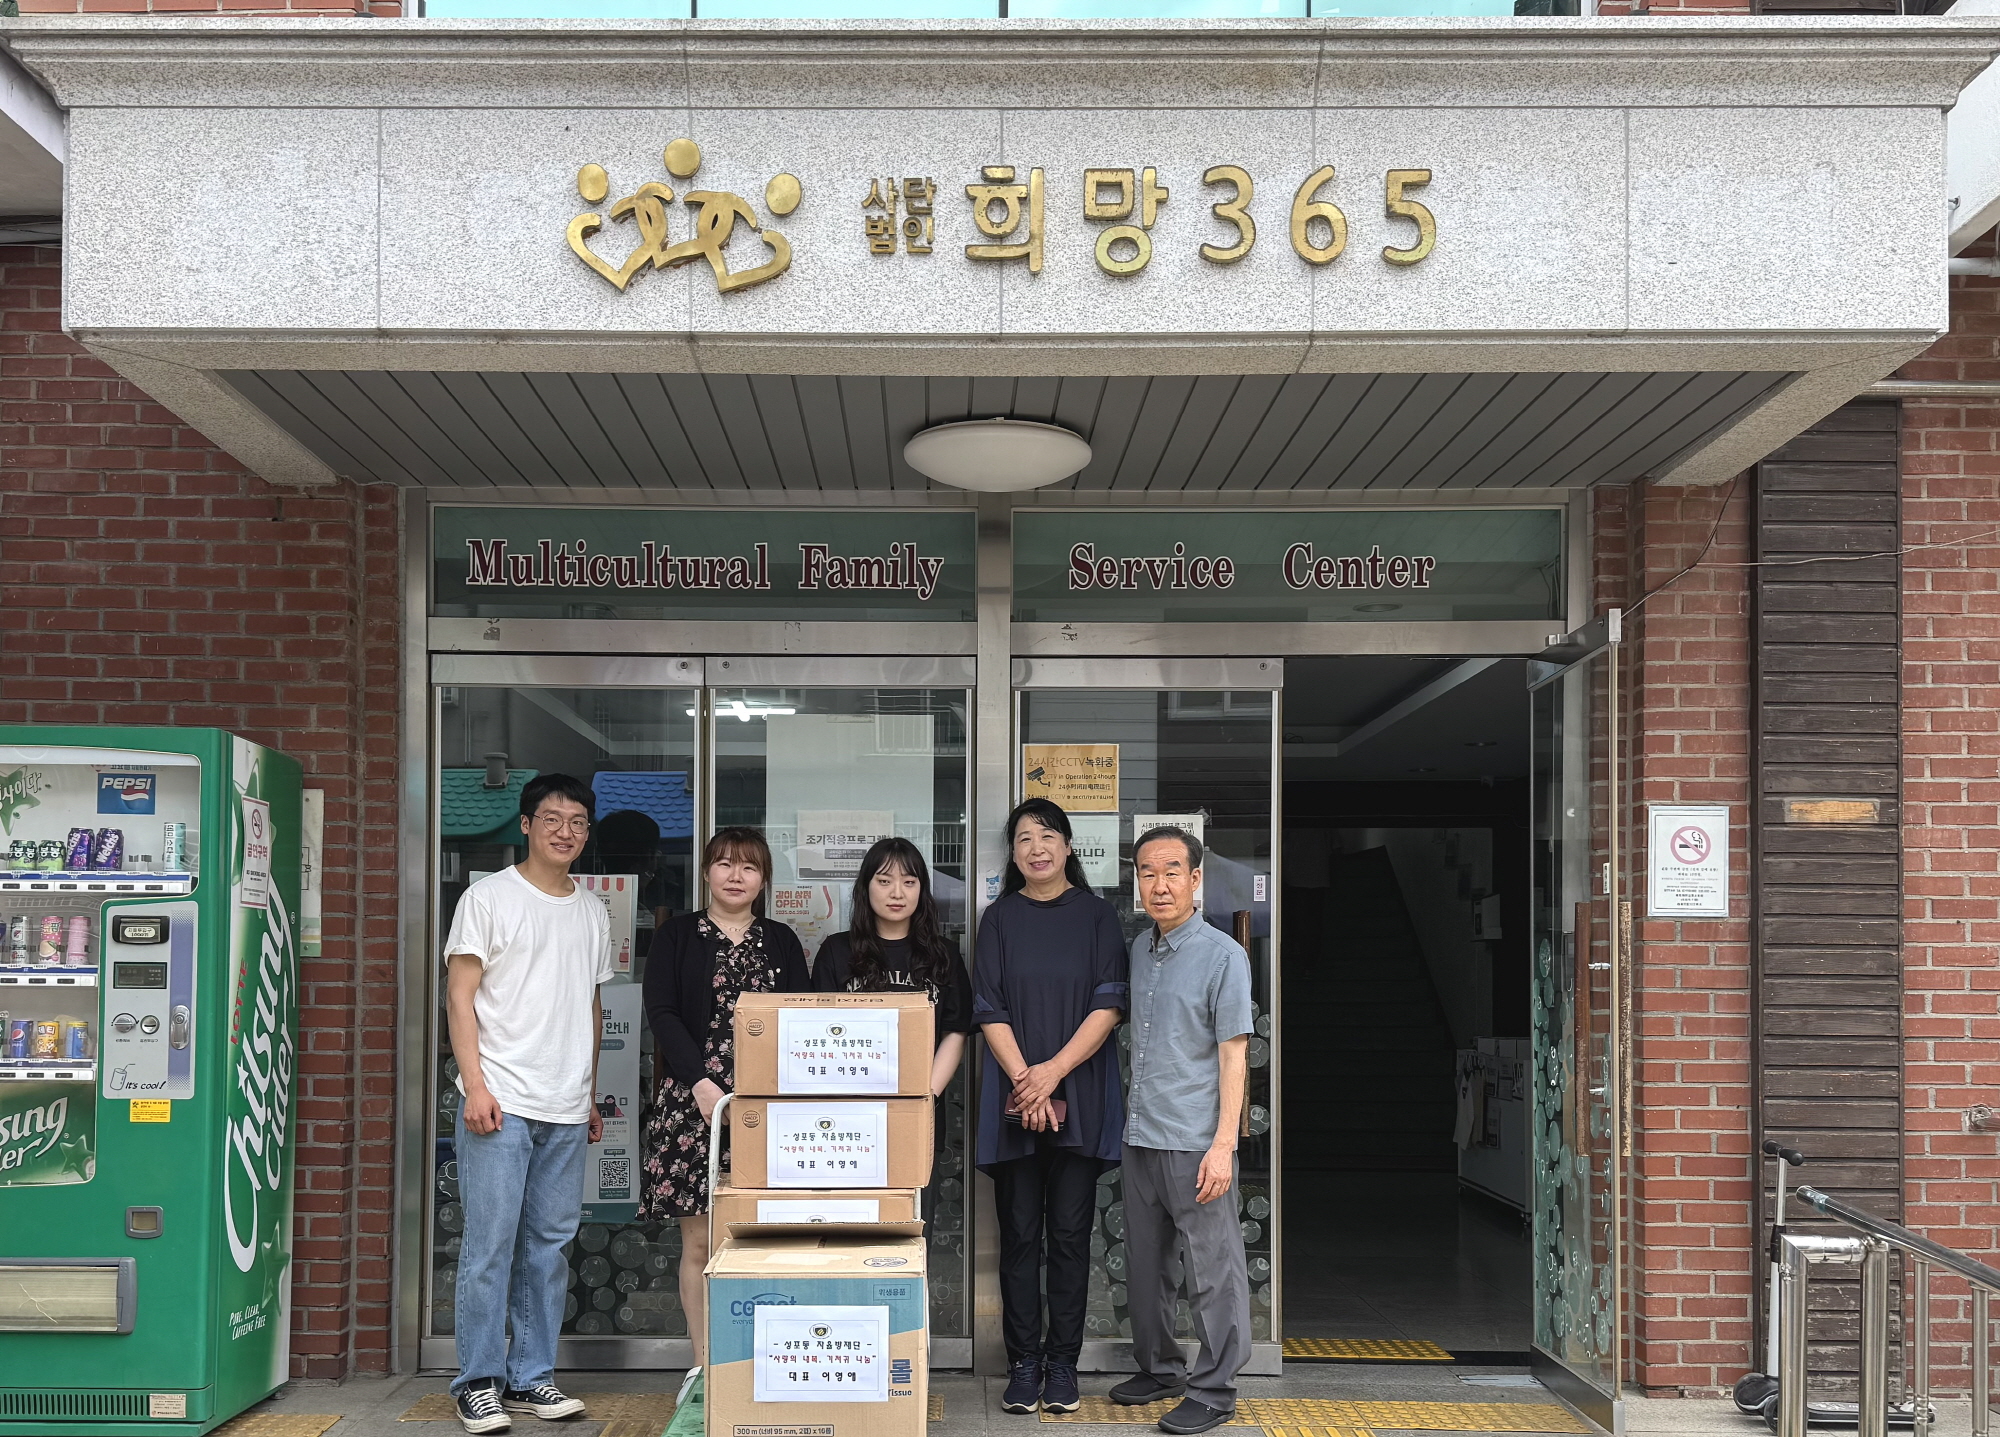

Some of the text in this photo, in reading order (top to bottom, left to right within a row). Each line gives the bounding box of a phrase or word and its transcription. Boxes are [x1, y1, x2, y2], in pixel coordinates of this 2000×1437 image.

[861, 176, 937, 216] 사단
[865, 214, 935, 255] 법인
[465, 538, 1436, 600] Multicultural Family Service Center
[1065, 773, 1093, 781] Operation
[101, 777, 152, 790] PEPSI
[775, 899, 804, 909] OPEN
[230, 957, 249, 1046] LOTTE
[605, 1021, 630, 1035] 안내
[803, 1039, 827, 1048] 성포동
[224, 872, 297, 1273] Chilsung
[808, 1066, 827, 1076] 대표
[125, 1080, 167, 1090] It's cool!
[266, 970, 295, 1191] Cider
[792, 1132, 816, 1141] 성포동
[797, 1160, 816, 1169] 대표
[878, 1288, 906, 1297] 위생용품
[254, 1314, 267, 1330] FREE
[784, 1340, 810, 1350] 성포동
[788, 1371, 810, 1382] 대표
